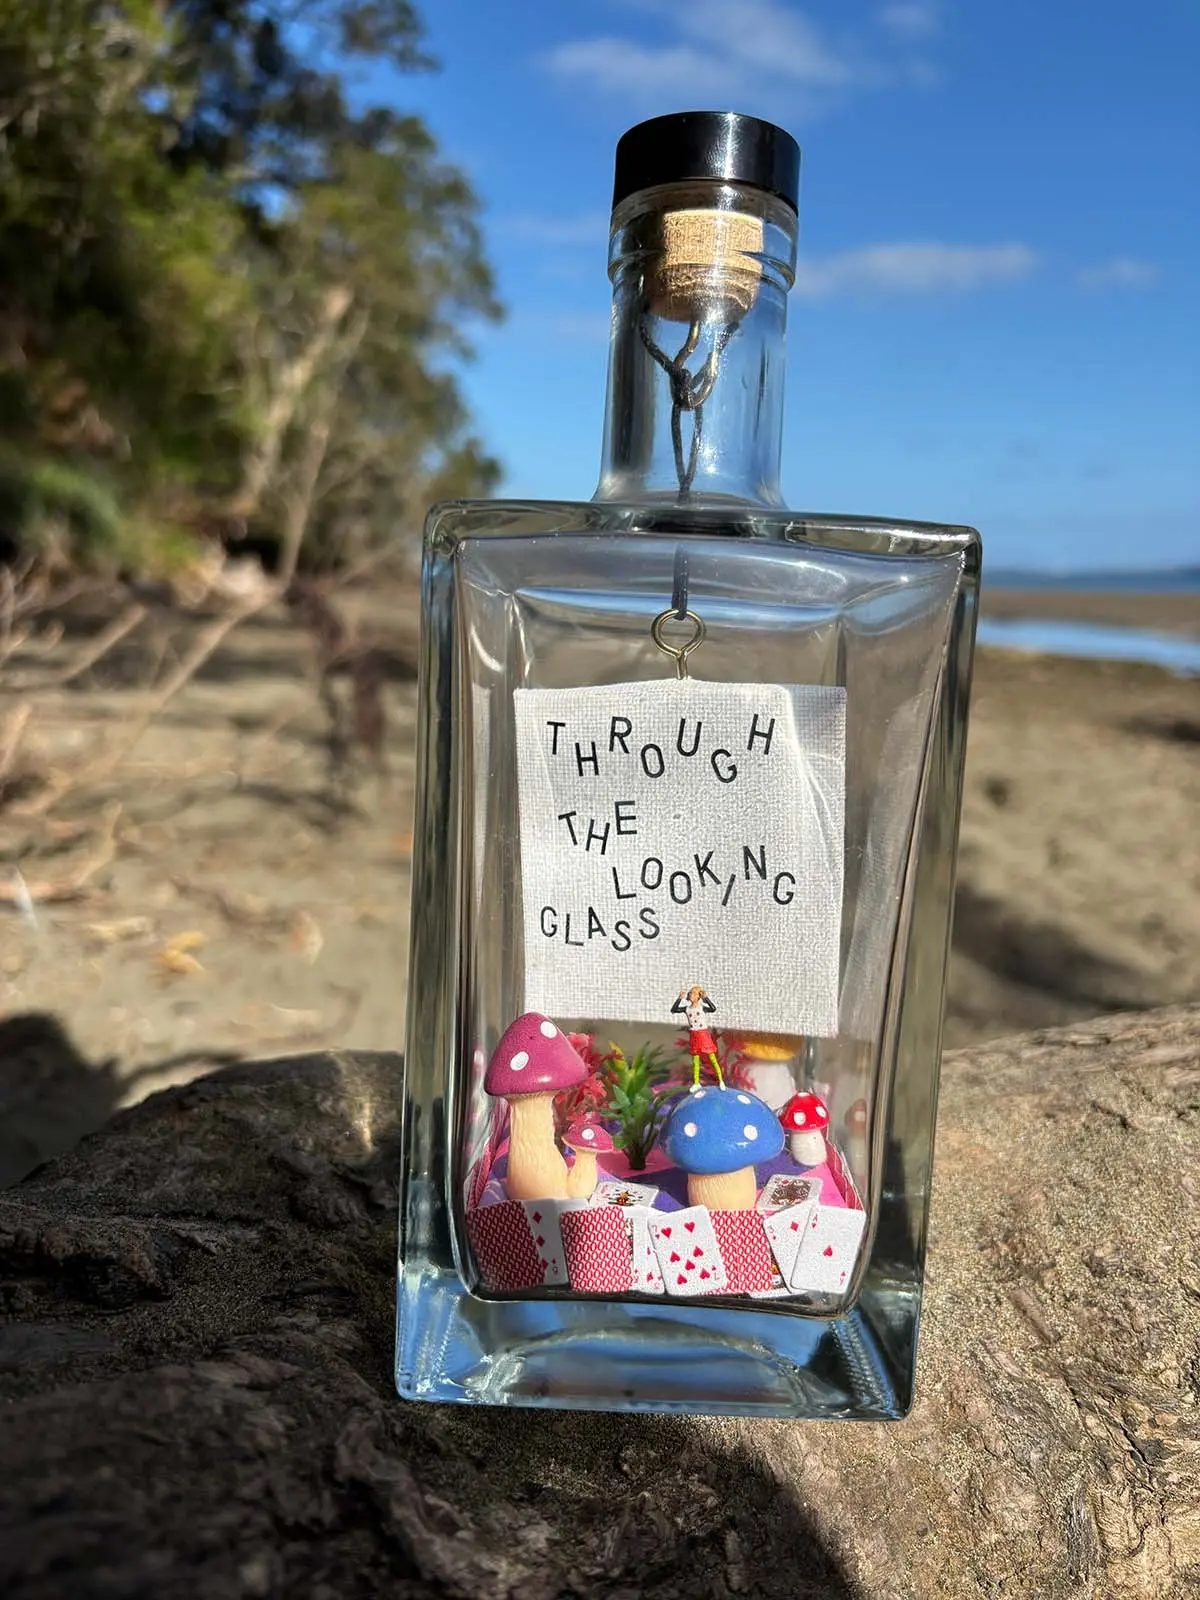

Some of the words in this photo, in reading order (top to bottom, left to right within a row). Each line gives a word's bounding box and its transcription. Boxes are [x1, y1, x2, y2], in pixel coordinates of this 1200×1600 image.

[547, 714, 775, 783] THROUGH
[558, 800, 637, 855] THE
[612, 845, 796, 907] LOOKING
[540, 906, 660, 951] GLASS
